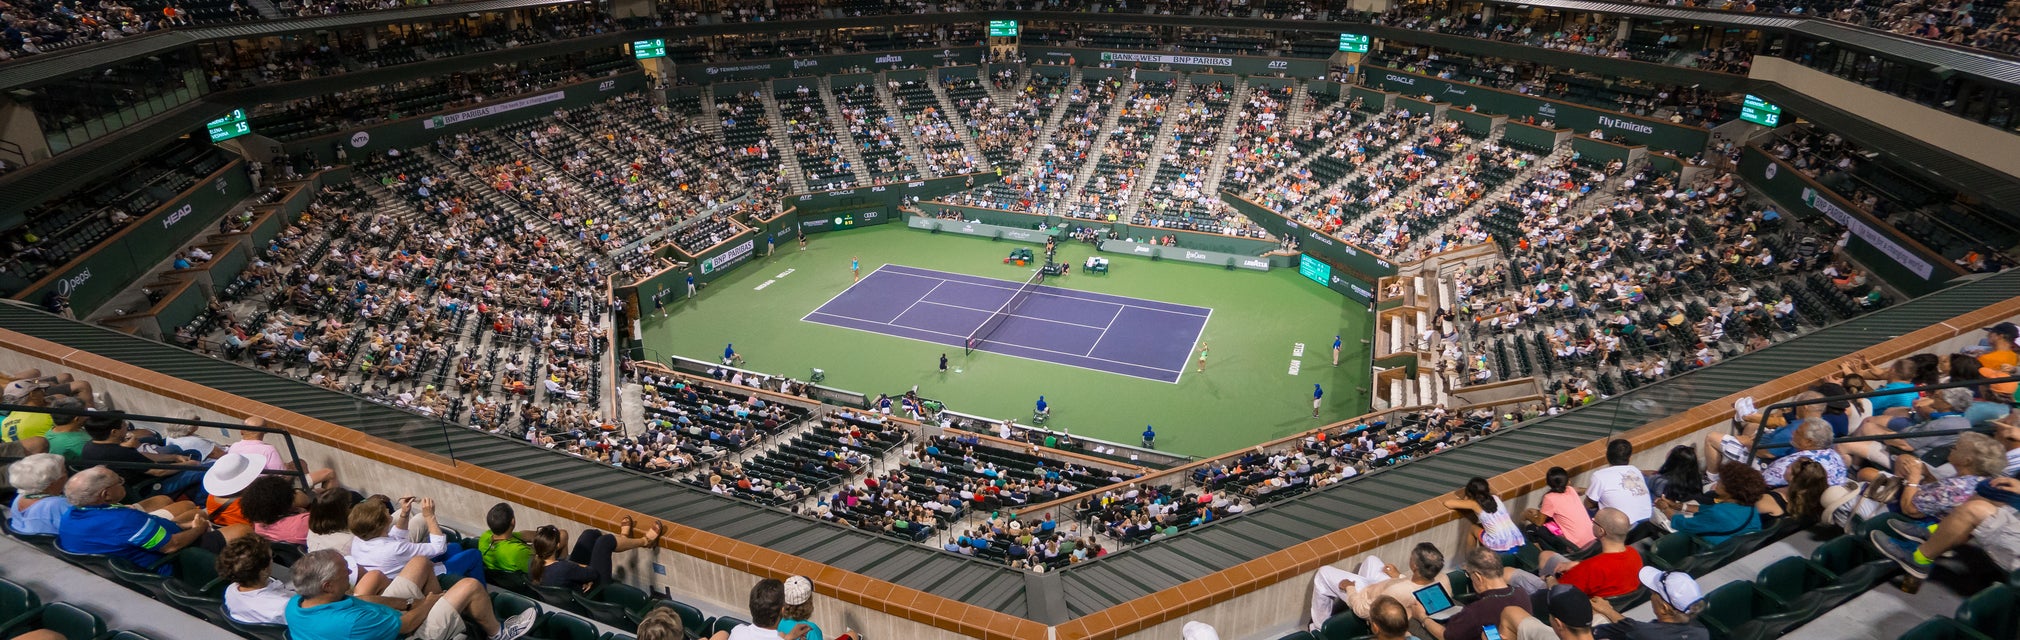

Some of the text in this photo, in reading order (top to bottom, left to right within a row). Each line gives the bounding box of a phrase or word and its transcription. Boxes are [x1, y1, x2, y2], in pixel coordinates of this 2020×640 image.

[1193, 57, 1230, 66] PARIBAS
[1268, 60, 1287, 69] ATP
[600, 80, 615, 90] ATP
[1386, 74, 1416, 85] ORACLE
[445, 115, 460, 124] BNP
[462, 108, 490, 119] PARIBAS
[1765, 114, 1777, 124] 15
[236, 122, 247, 132] 15
[1598, 116, 1653, 134] Fly Emirates
[162, 204, 192, 229] HEAD
[1815, 199, 1827, 212] BNP
[1828, 203, 1850, 225] PARIBAS
[714, 241, 752, 266] BNP PARIBAS
[1376, 259, 1390, 268] WTA
[70, 267, 91, 291] pepsi
